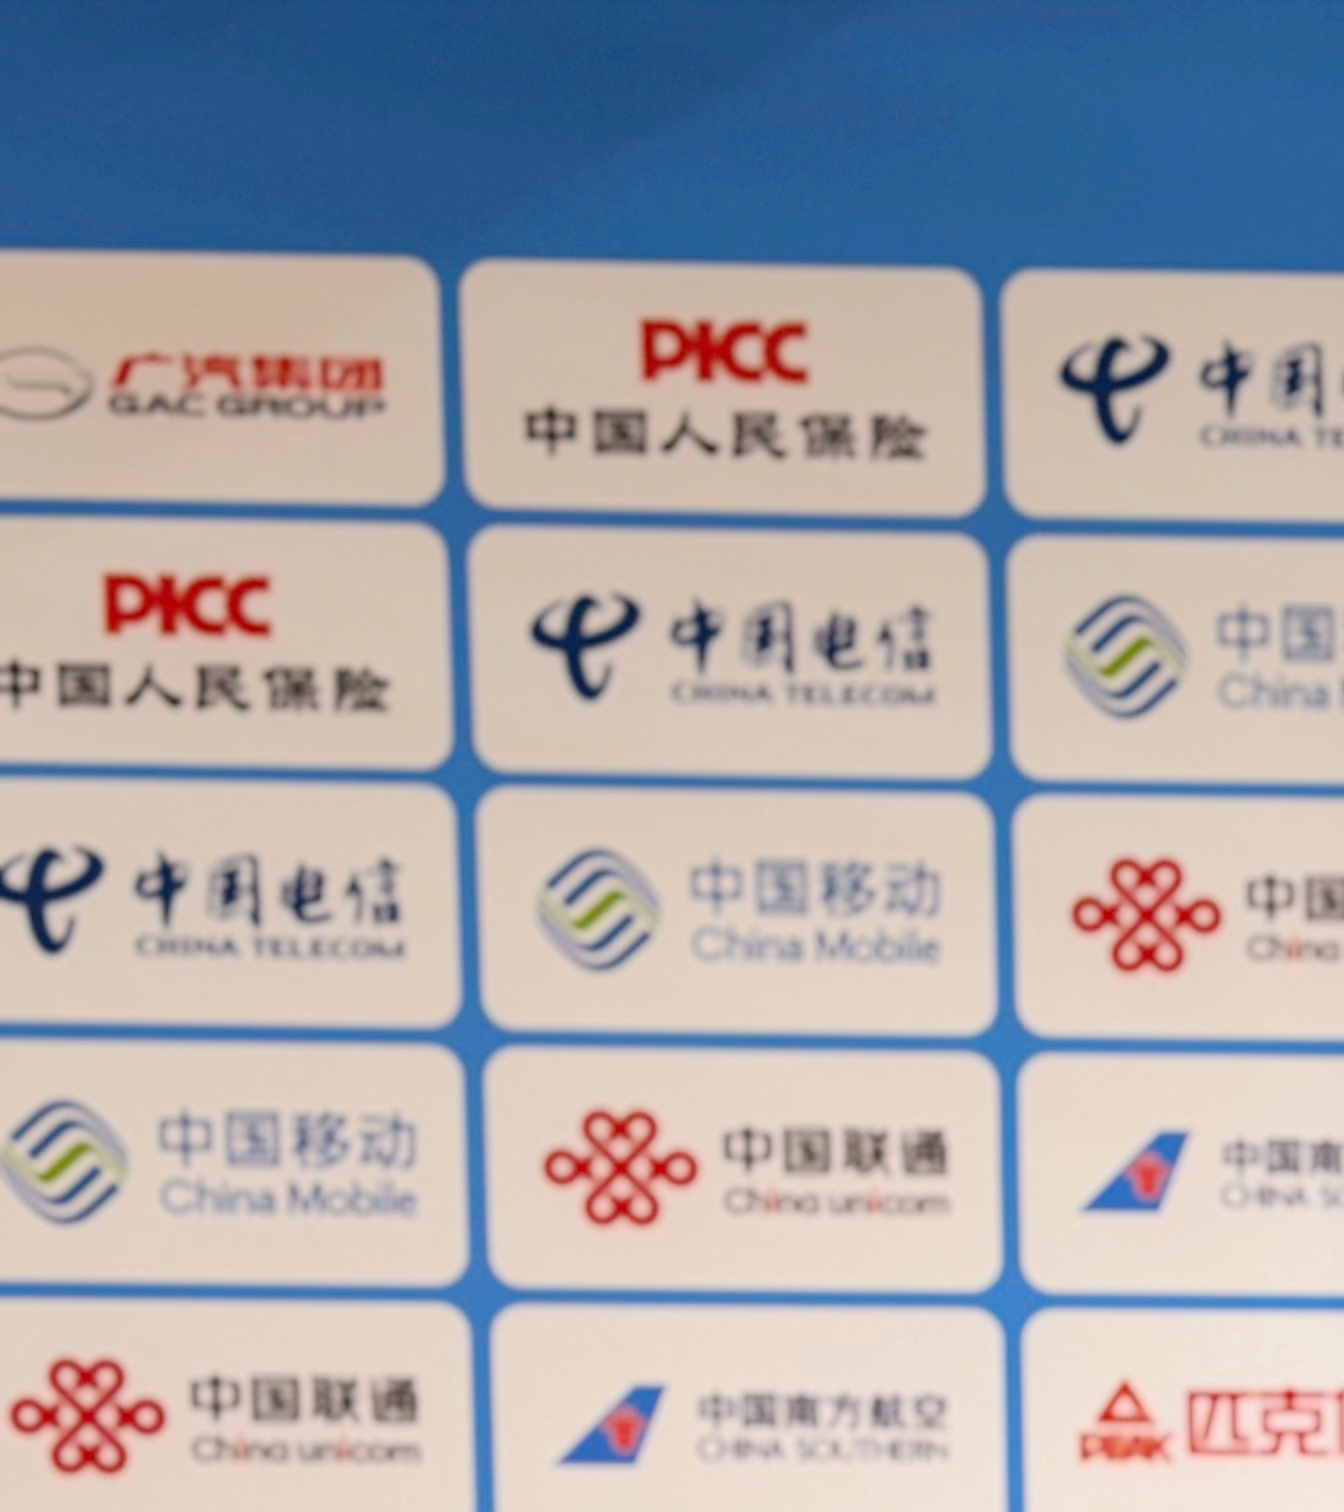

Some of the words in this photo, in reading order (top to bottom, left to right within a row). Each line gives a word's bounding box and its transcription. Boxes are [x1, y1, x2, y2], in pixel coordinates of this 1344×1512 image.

[641, 319, 807, 383] PICC
[109, 394, 204, 415] GAC
[219, 396, 383, 417] GROUP
[524, 403, 926, 464] 中国人民保险
[104, 573, 270, 636] PICC
[668, 597, 933, 677] 中国电信
[0, 657, 389, 716] 中国人民保险
[1217, 673, 1328, 709] China
[132, 850, 402, 930] 中国电信
[689, 856, 940, 918] 中国移动
[690, 926, 802, 962] China
[816, 927, 940, 963] Mobile
[1246, 933, 1339, 962] China
[157, 1108, 416, 1170] 中国移动
[723, 1126, 945, 1176] 中国联通
[159, 1179, 274, 1215] China
[288, 1179, 416, 1216] Mobile
[723, 1186, 818, 1215] China
[190, 1374, 415, 1423] 中国联通
[697, 1393, 946, 1428] 中国南方航空
[191, 1434, 287, 1463] China
